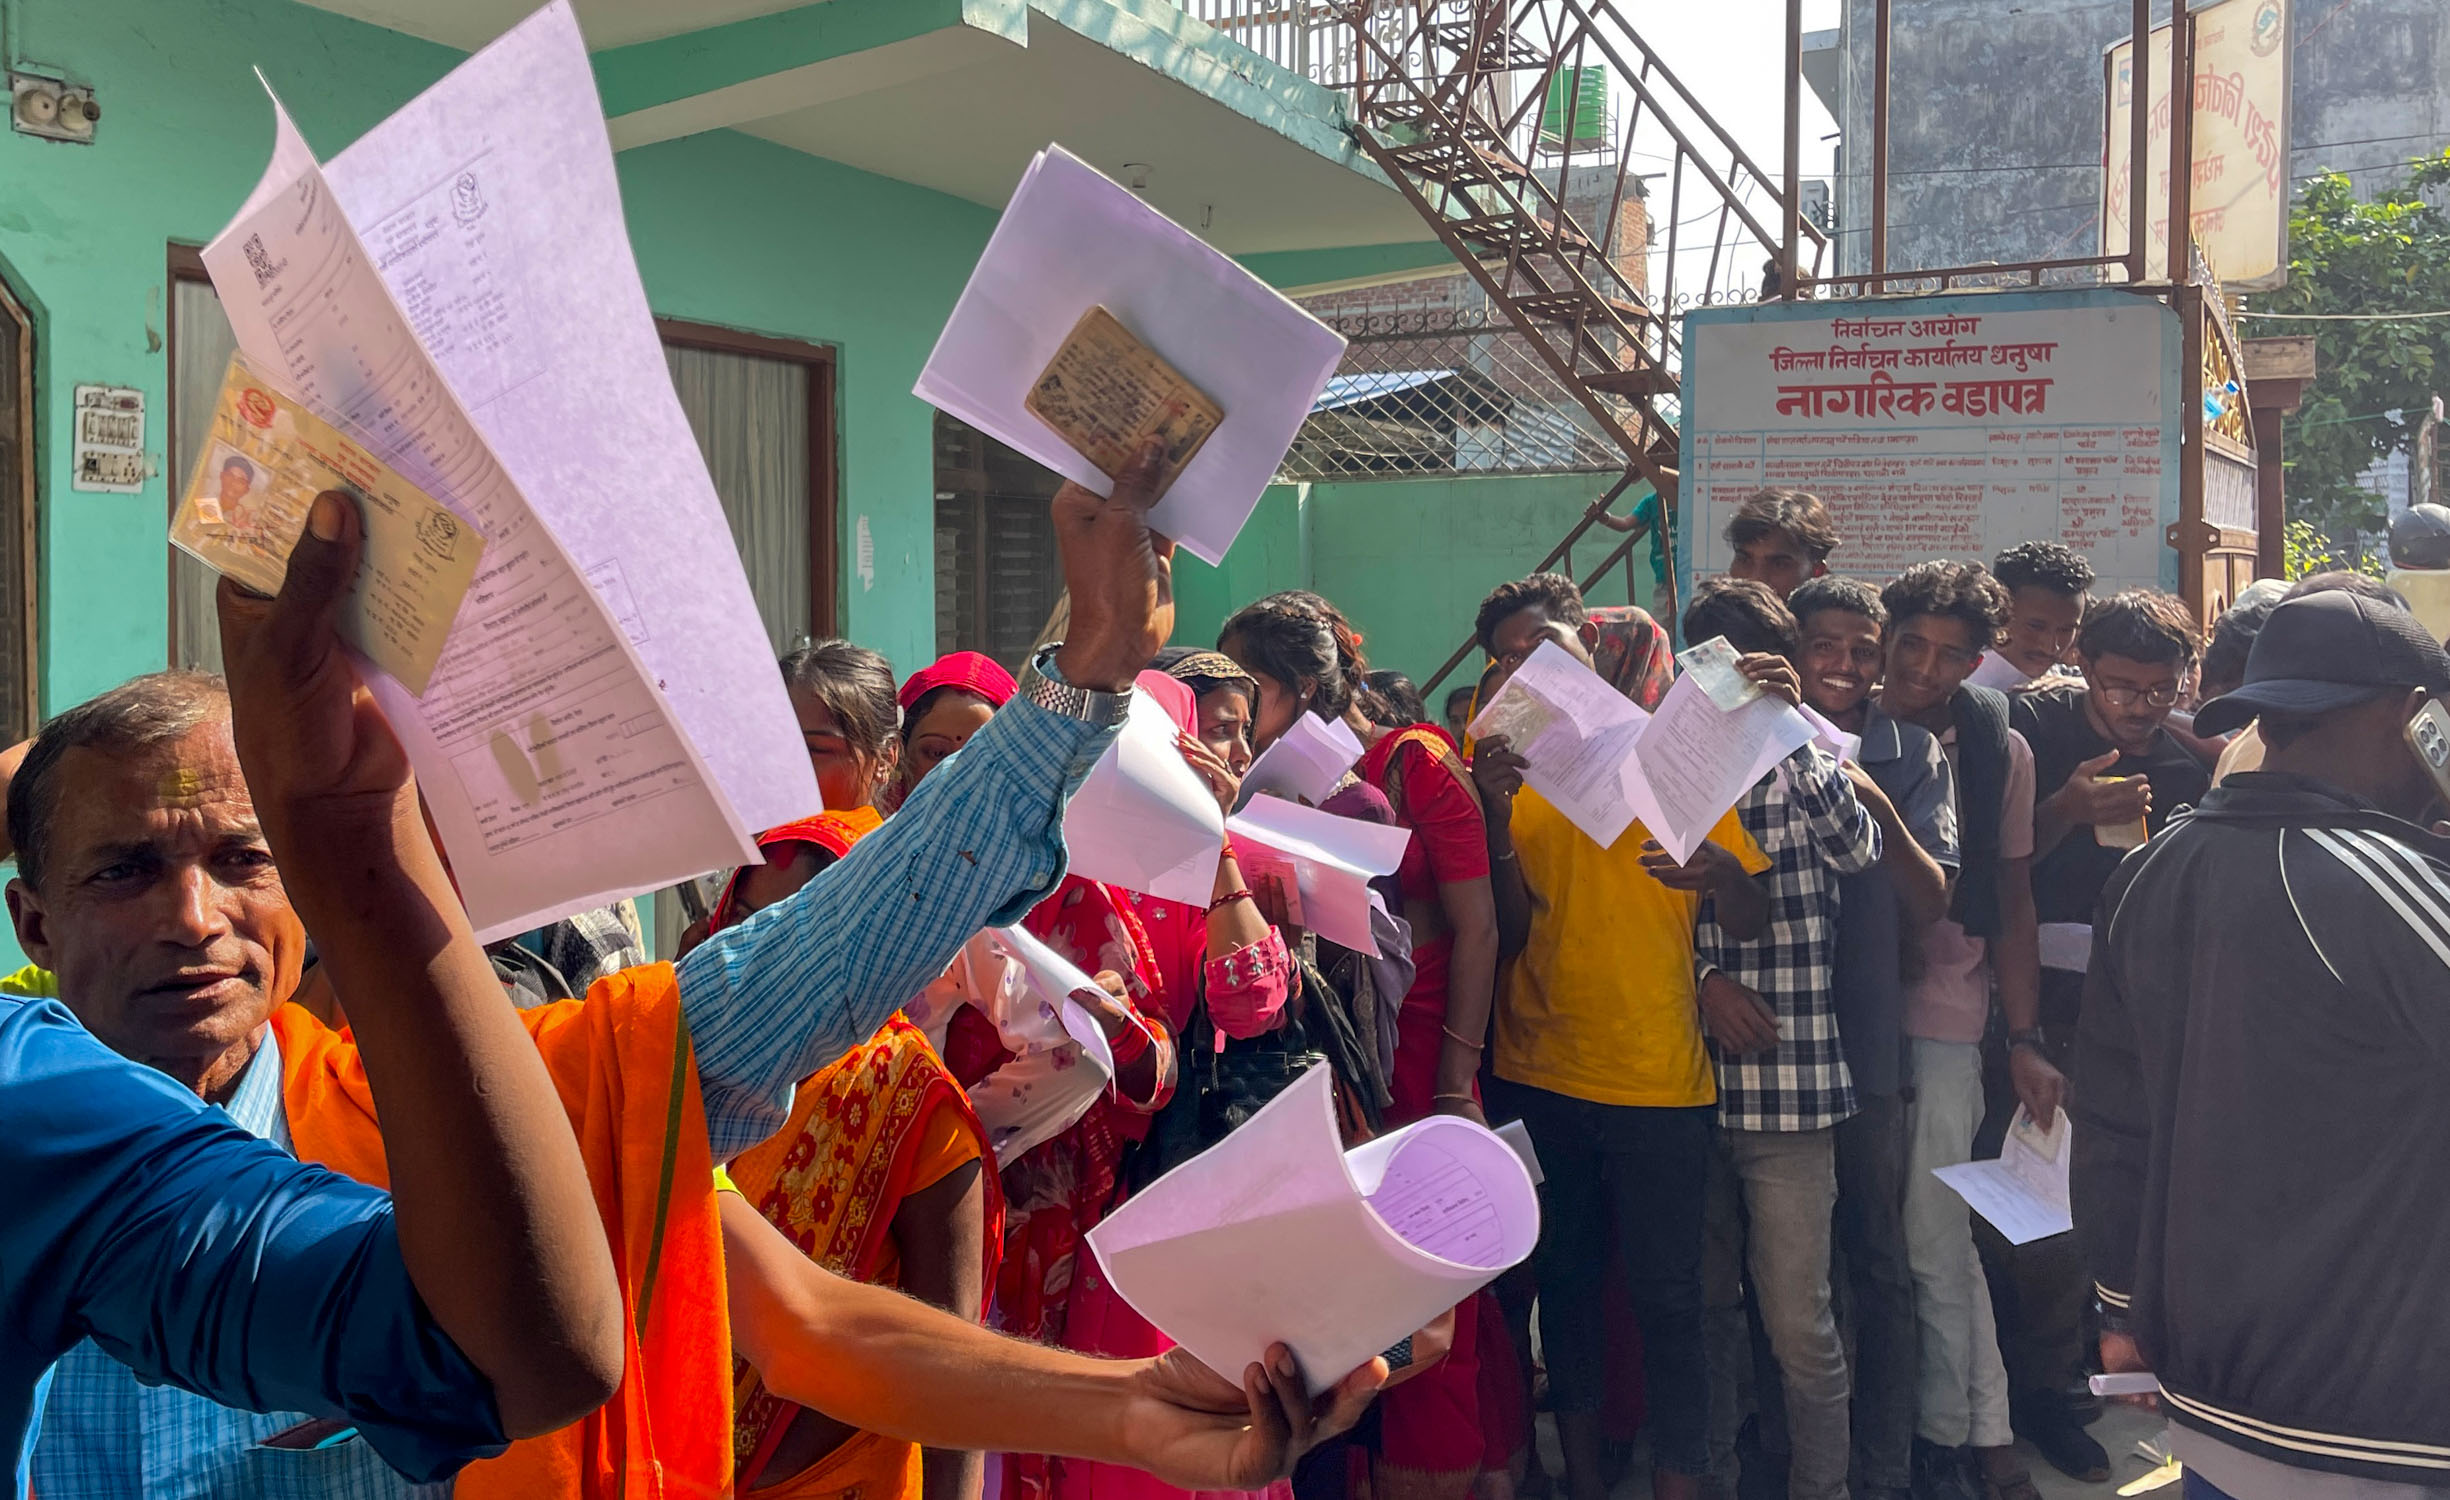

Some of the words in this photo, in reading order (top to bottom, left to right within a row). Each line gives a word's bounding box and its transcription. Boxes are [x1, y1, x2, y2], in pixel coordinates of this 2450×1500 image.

[1831, 315, 1907, 339] निर्वाचन
[1908, 313, 1982, 337] आयोग
[1769, 346, 1827, 373] जिल्ला
[1828, 342, 1903, 370] निर्वाचन
[1903, 339, 1988, 368] कार्यालय
[1990, 342, 2059, 373] धनुषा
[1775, 370, 1937, 421] नागरिक
[1941, 377, 2055, 417] वडापत्र
